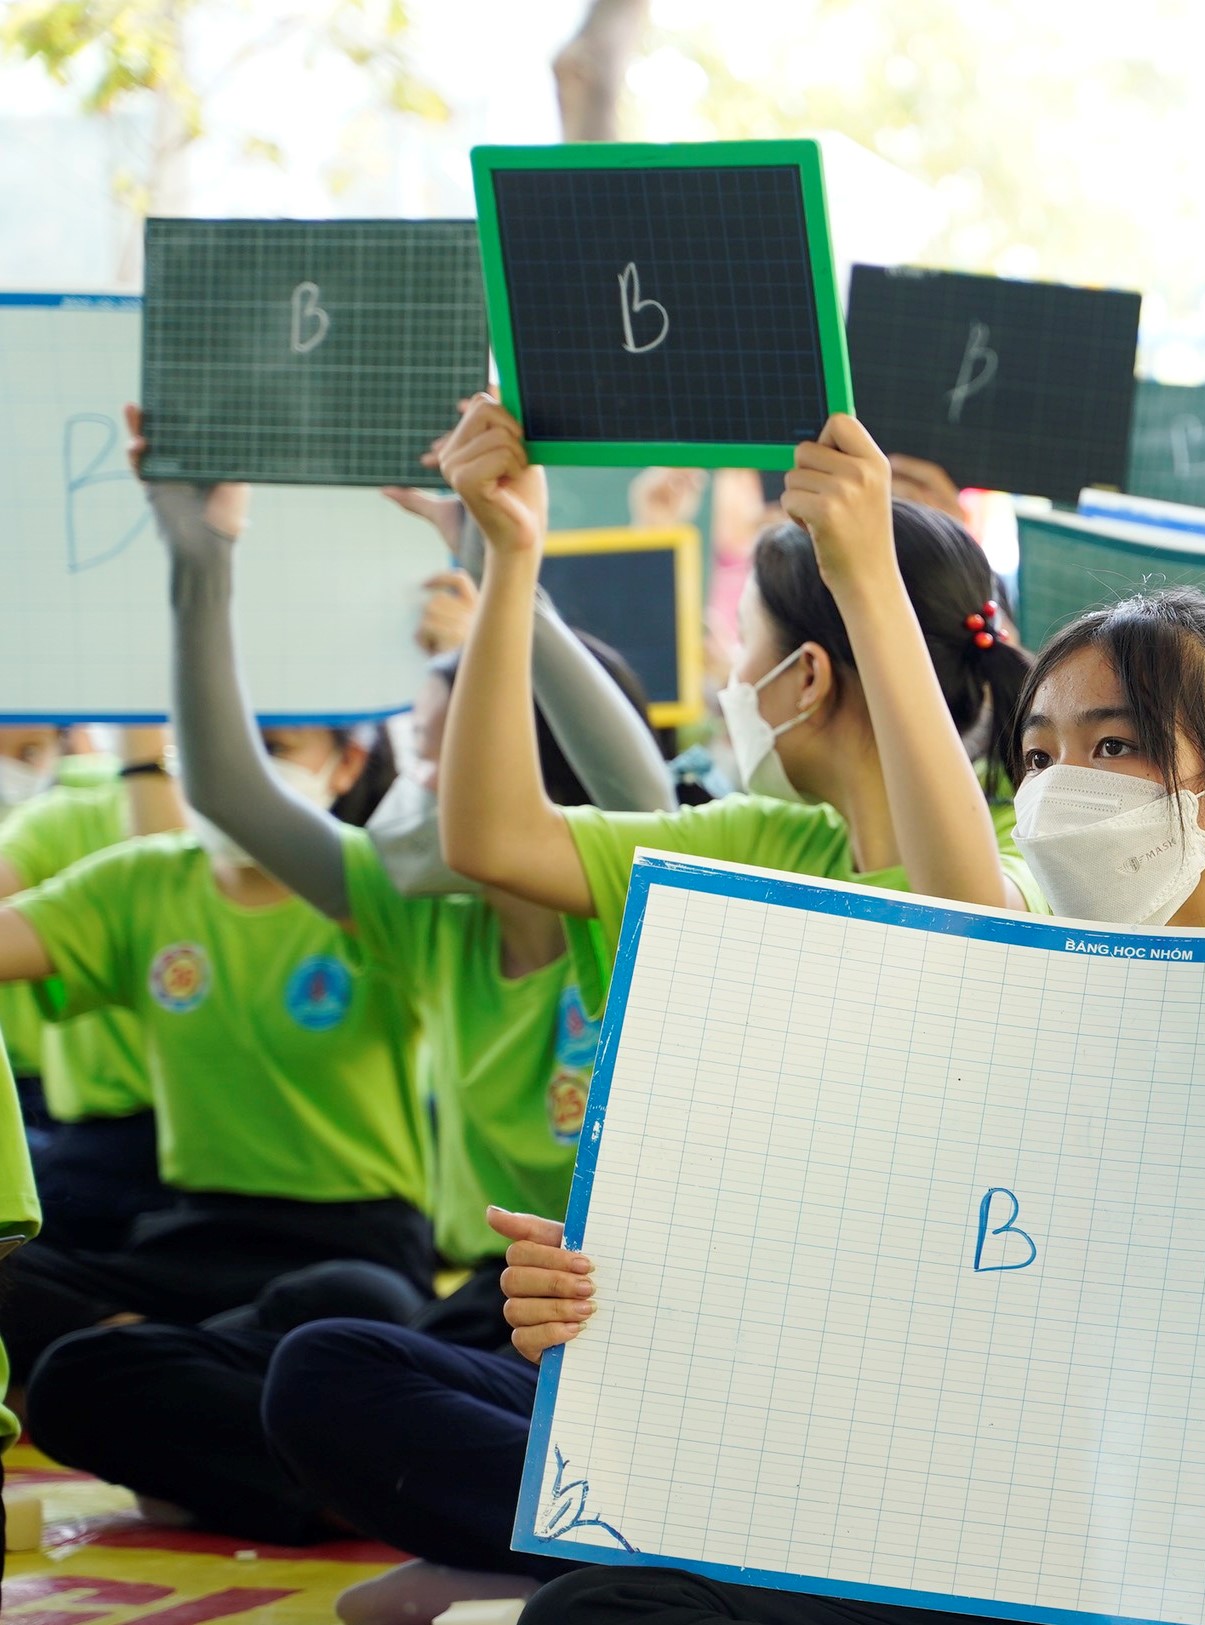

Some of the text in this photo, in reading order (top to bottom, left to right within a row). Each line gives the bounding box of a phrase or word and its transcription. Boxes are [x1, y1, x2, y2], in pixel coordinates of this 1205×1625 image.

[290, 281, 330, 353] B
[617, 262, 670, 353] B
[1113, 946, 1146, 959] HỌC
[1150, 947, 1193, 960] NHÓM
[974, 1187, 1037, 1272] B
